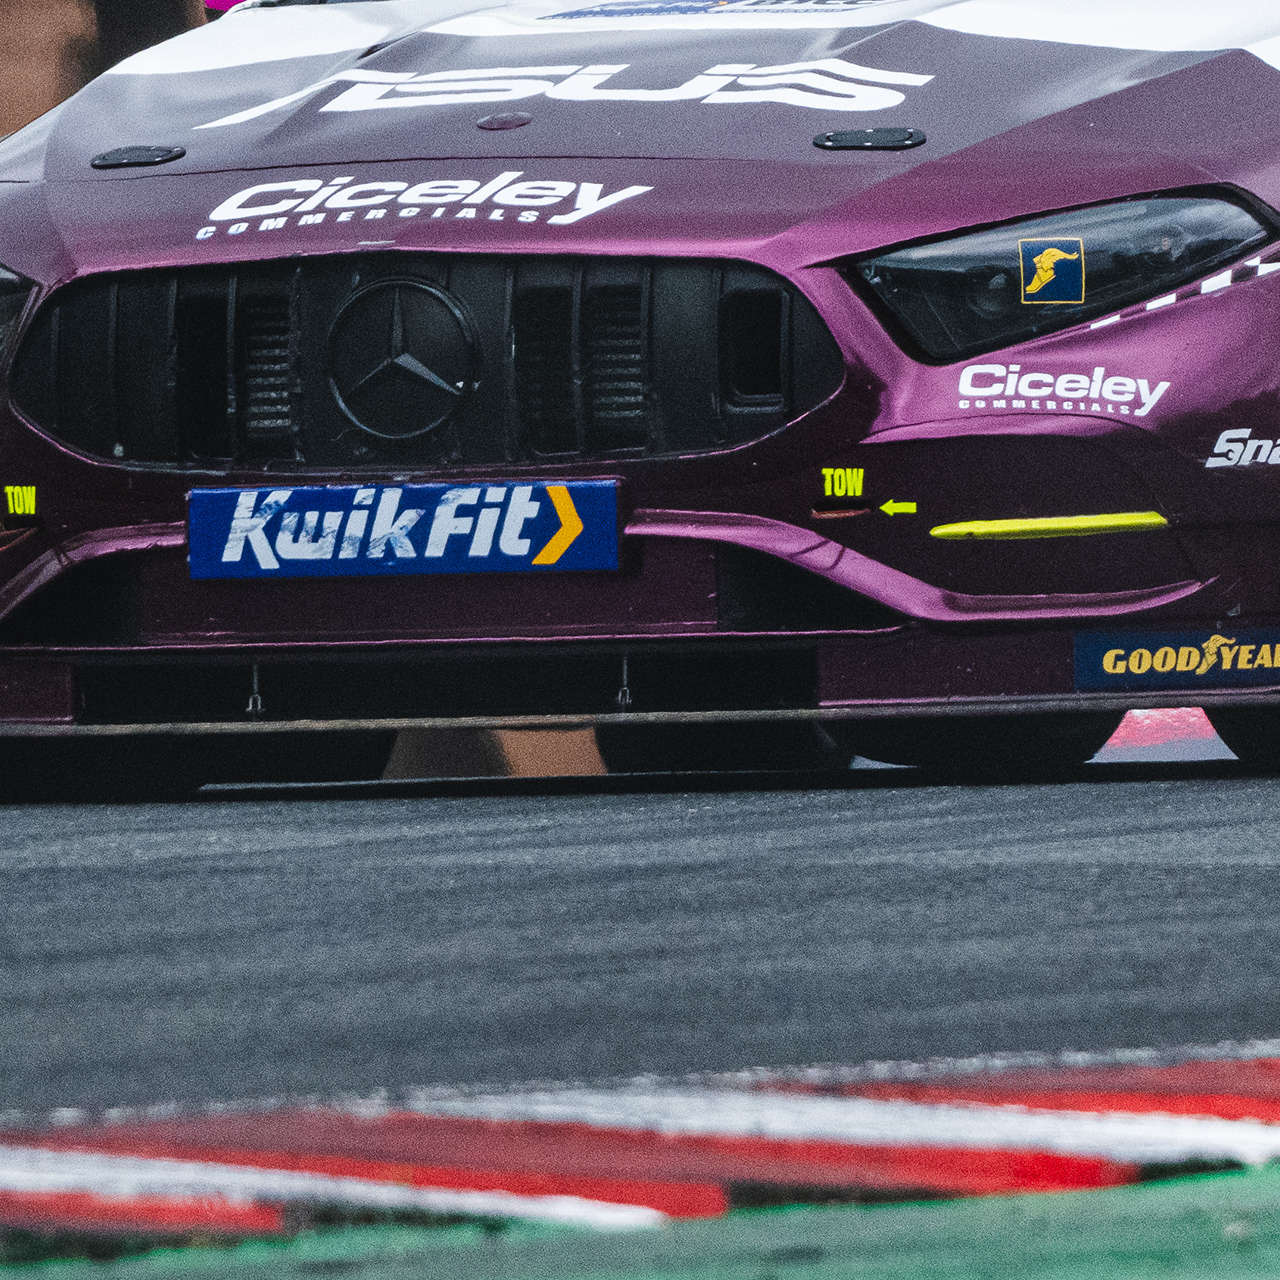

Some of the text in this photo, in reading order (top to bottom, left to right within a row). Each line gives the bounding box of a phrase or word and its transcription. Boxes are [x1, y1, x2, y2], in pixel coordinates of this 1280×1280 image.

[193, 58, 935, 129] ASUS
[208, 171, 654, 225] Ciceley
[196, 206, 538, 240] COMMERCIALS
[958, 364, 1171, 417] Ciceley
[958, 399, 1131, 415] COMMERCIALS
[821, 467, 865, 497] TOW
[4, 486, 36, 515] TOW
